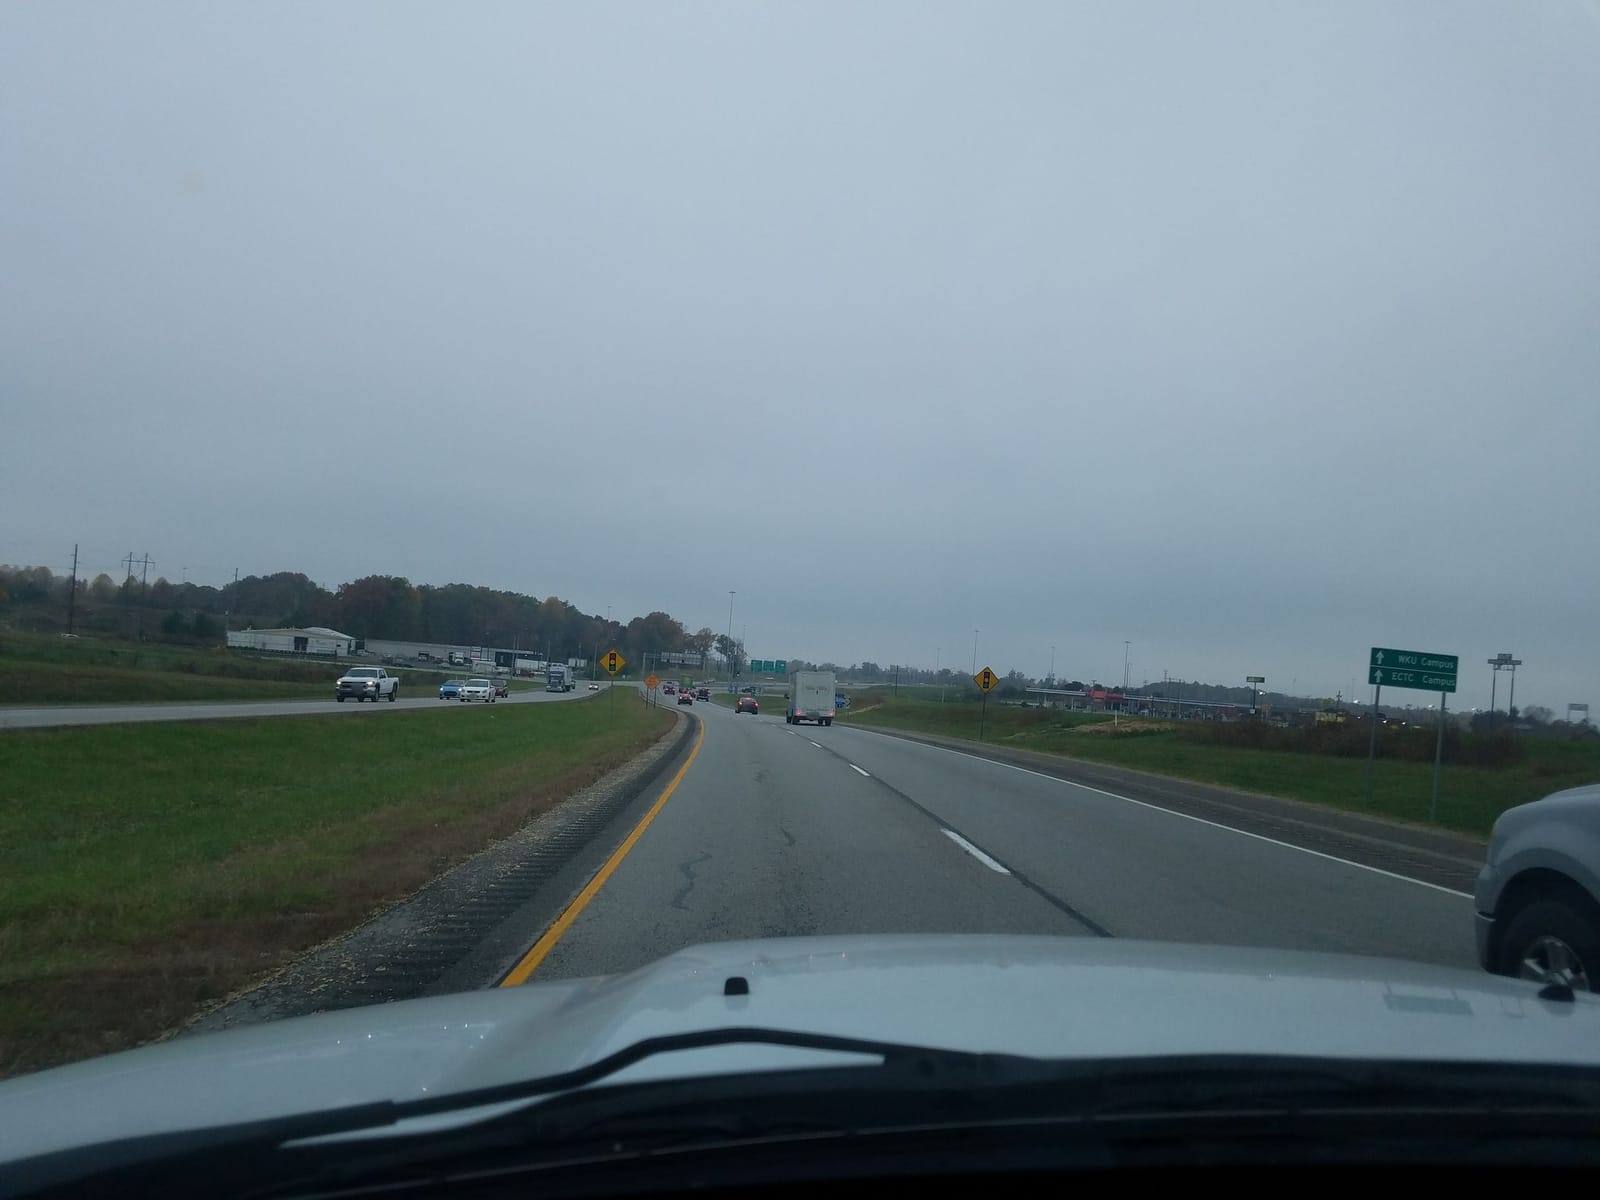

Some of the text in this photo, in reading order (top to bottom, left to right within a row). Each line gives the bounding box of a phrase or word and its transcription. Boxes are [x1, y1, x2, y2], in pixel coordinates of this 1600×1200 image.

[1398, 655, 1454, 669] WKU Campus
[1391, 672, 1456, 687] ECTC Campus
